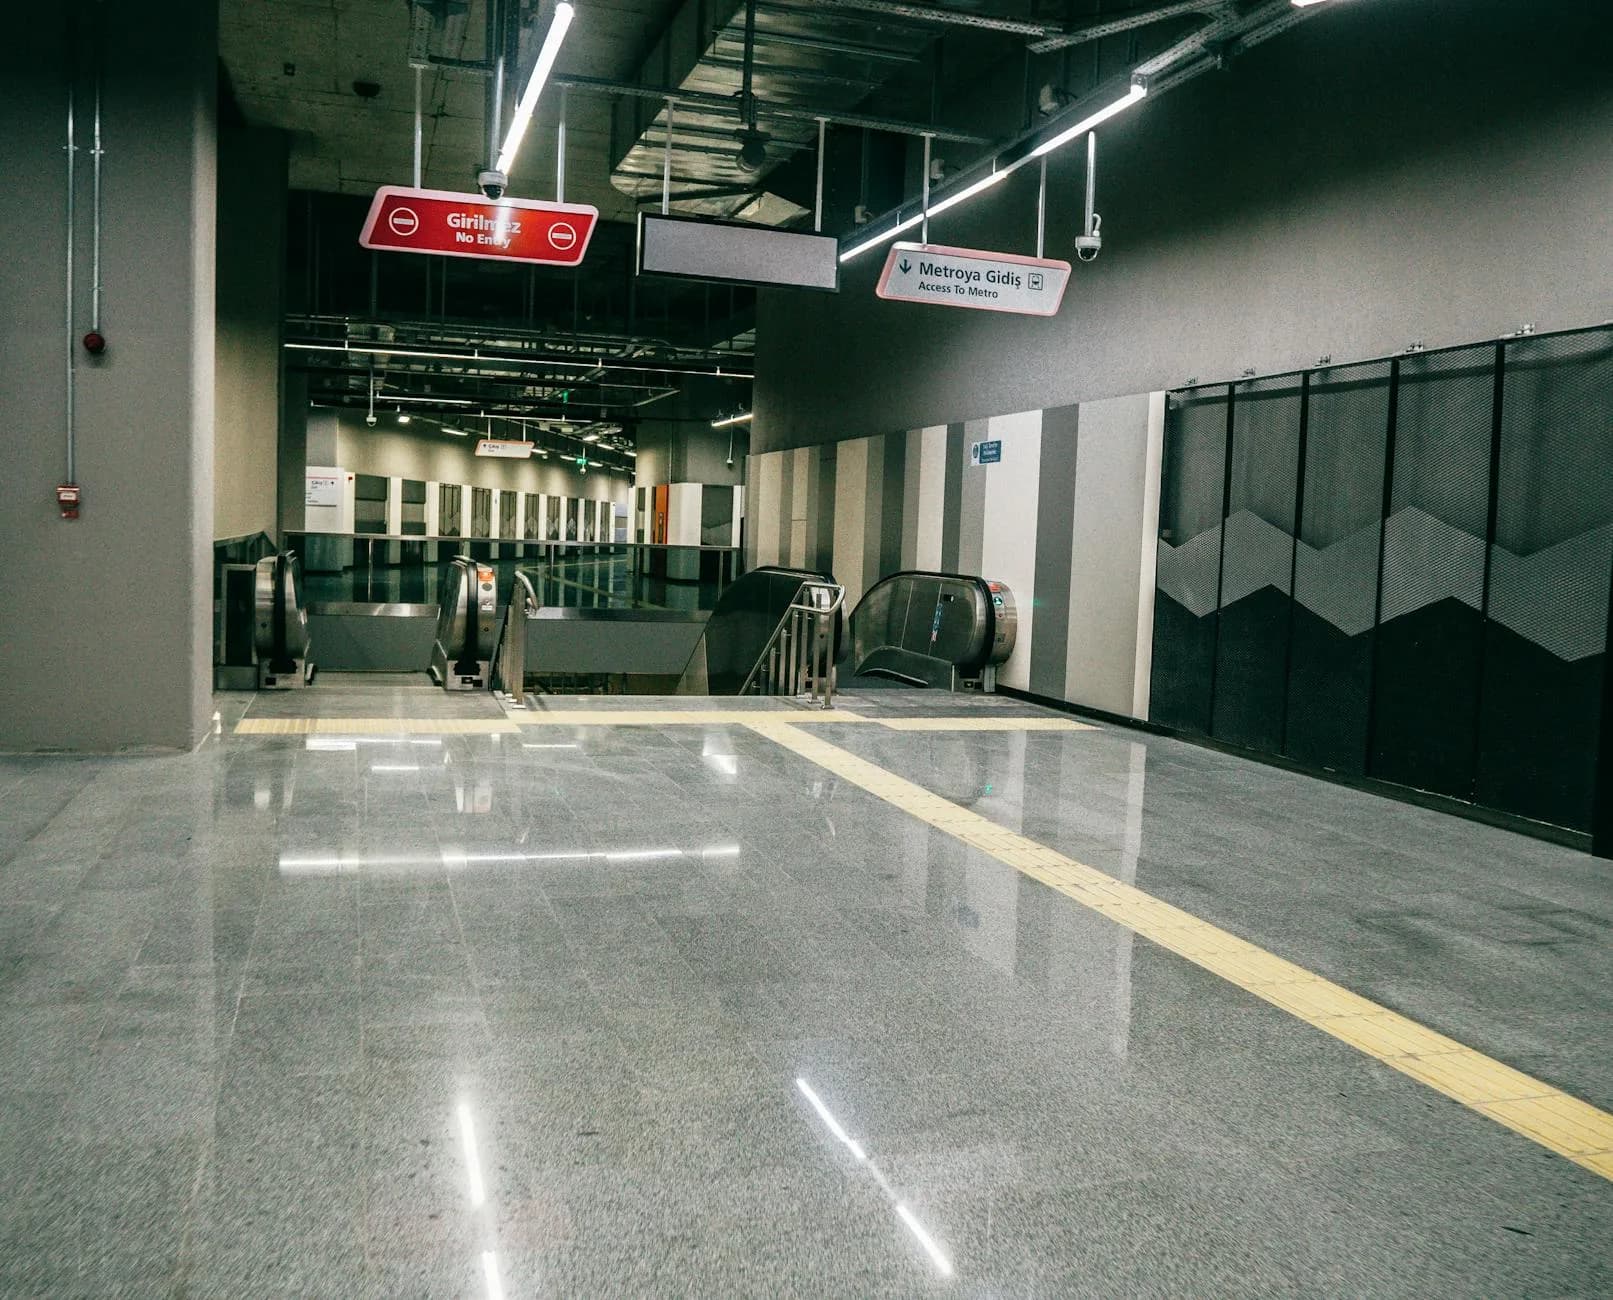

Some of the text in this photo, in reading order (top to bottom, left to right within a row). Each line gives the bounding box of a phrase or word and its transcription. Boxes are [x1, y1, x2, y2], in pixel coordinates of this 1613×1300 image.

[455, 231, 511, 249] No Enty
[919, 262, 1022, 289] Metroya Gidiş
[918, 281, 999, 299] Access To Metro
